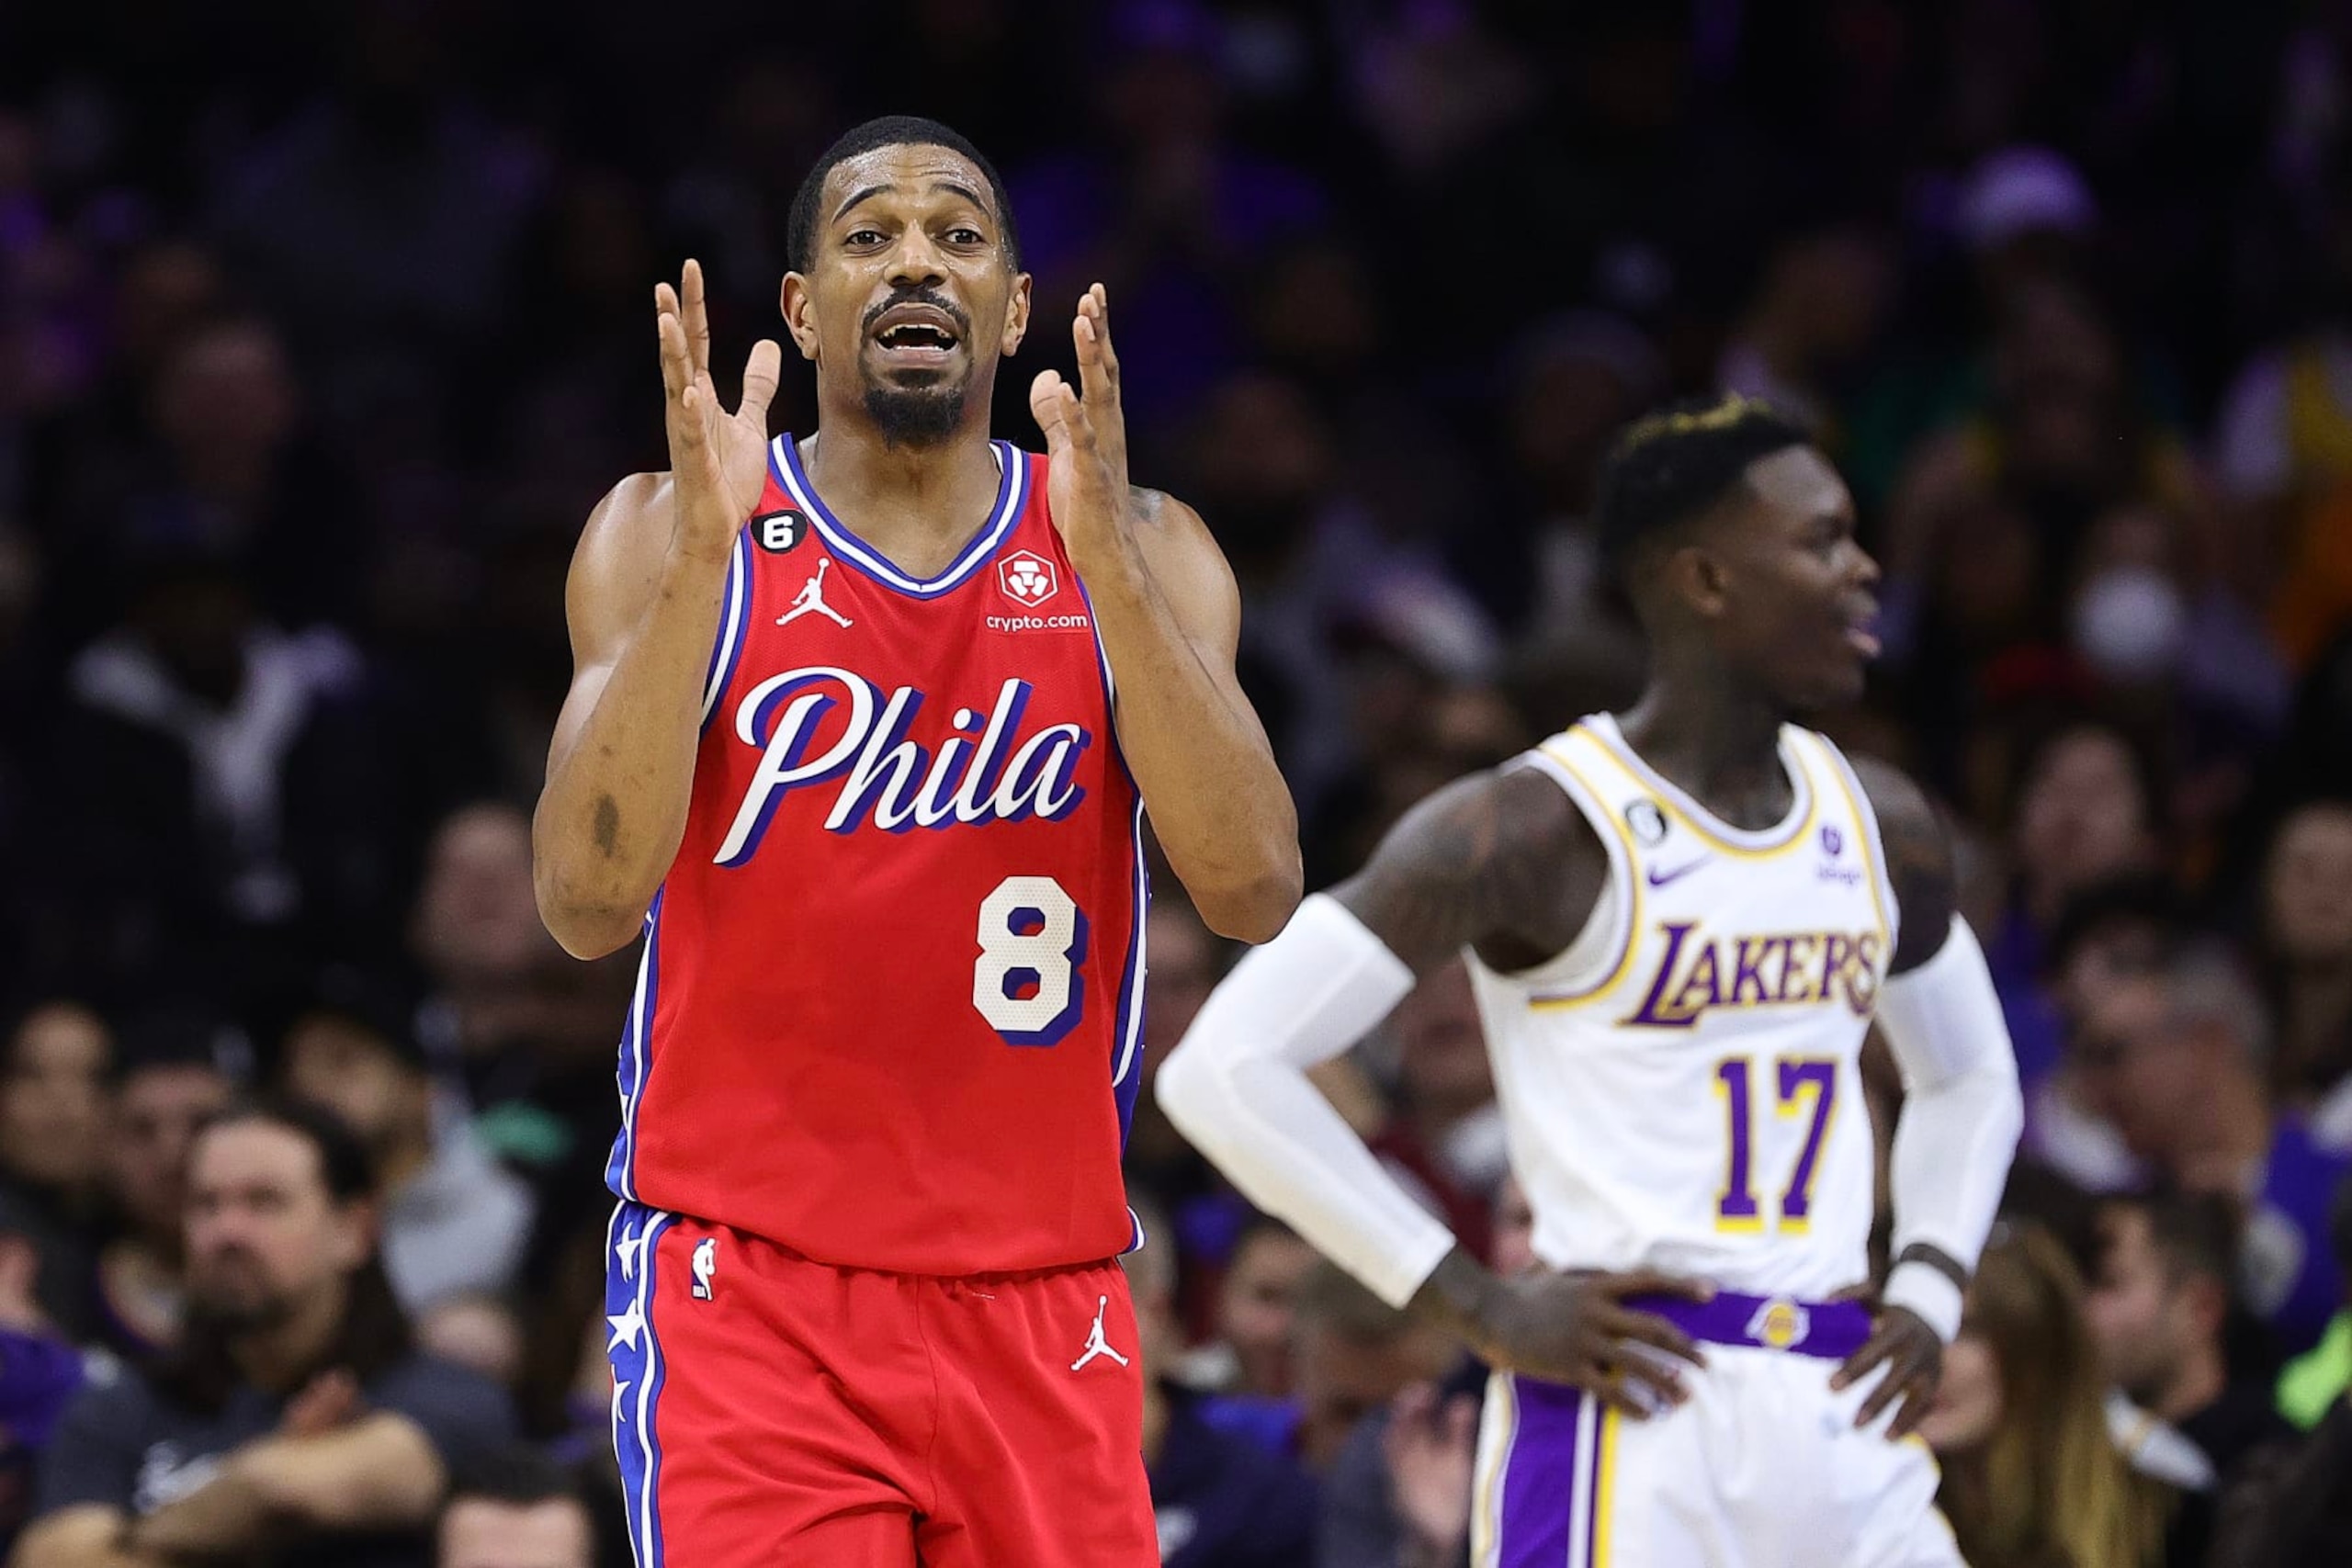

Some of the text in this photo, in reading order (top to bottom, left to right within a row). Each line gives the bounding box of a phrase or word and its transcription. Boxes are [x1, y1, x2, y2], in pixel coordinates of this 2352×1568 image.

[763, 515, 794, 548] 6
[986, 615, 1088, 631] crypto.com
[712, 666, 1091, 868] Phila
[972, 874, 1091, 1046] 8
[1614, 920, 1880, 1028] LAKERS
[1714, 1055, 1840, 1233] 17
